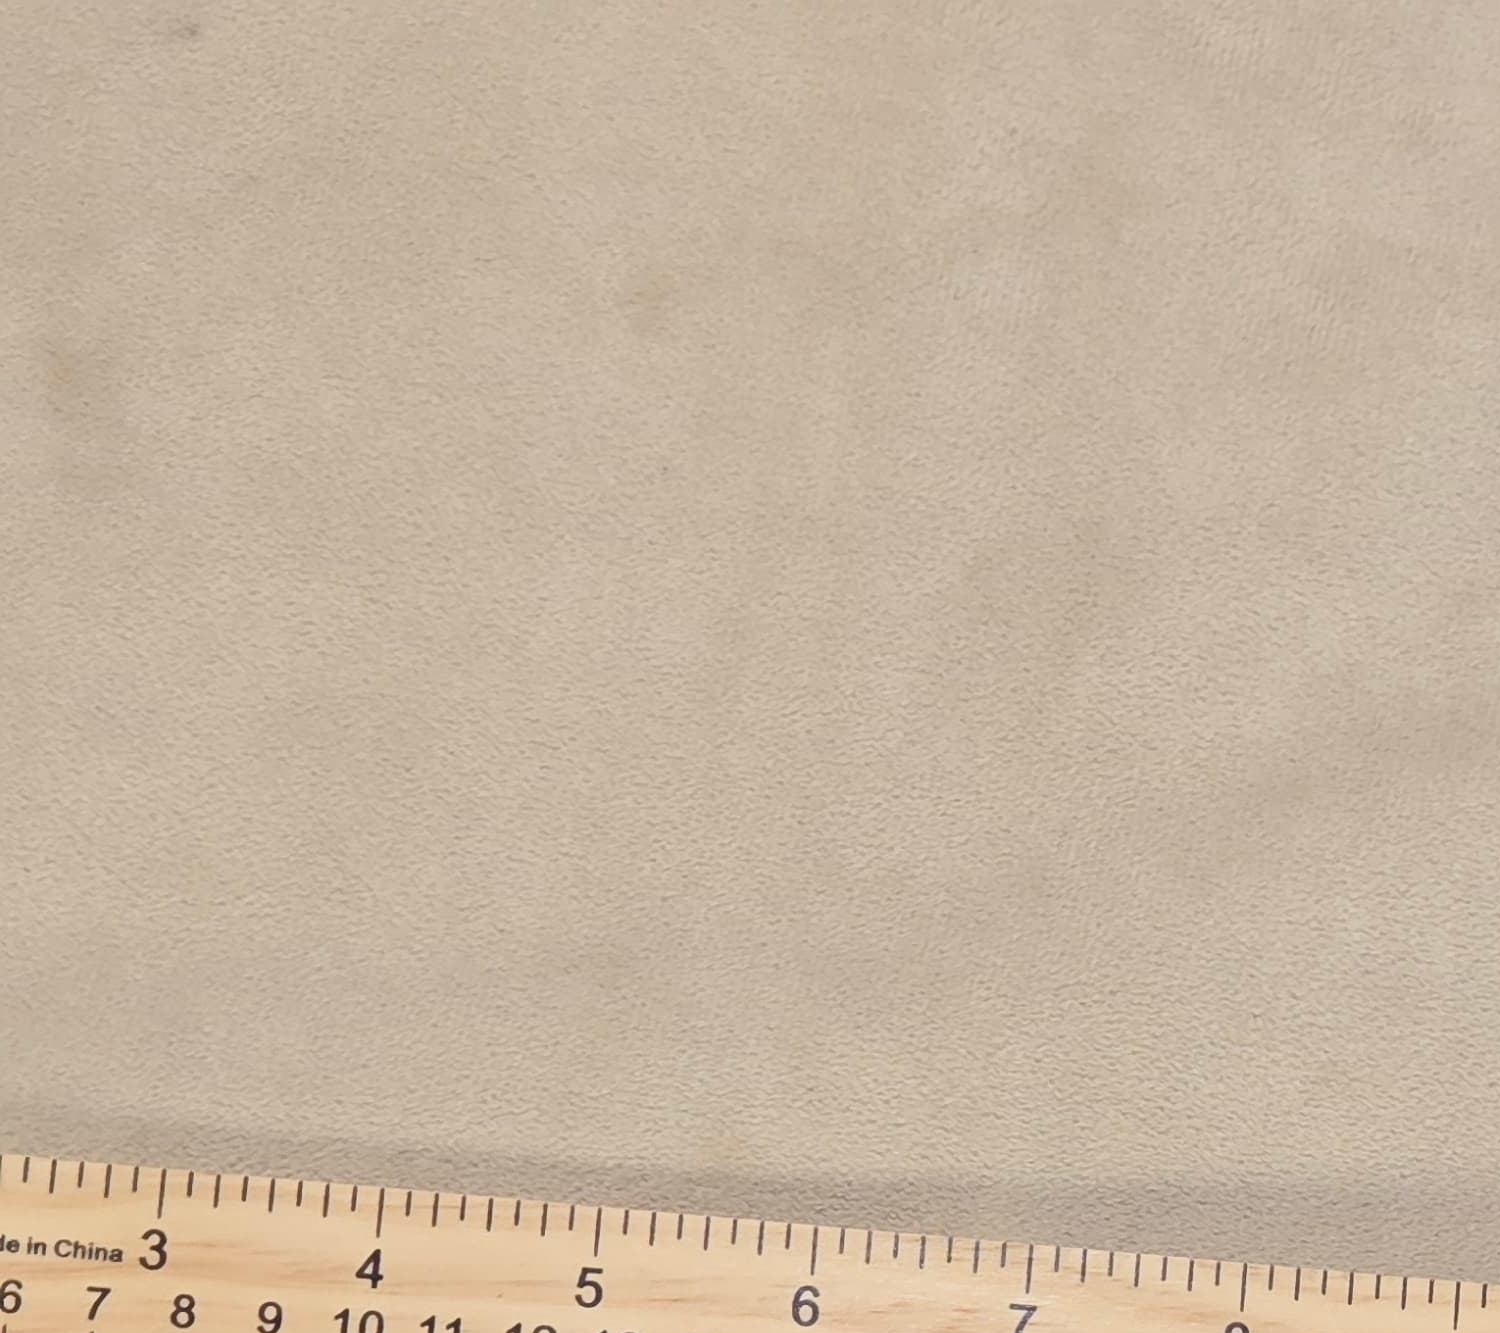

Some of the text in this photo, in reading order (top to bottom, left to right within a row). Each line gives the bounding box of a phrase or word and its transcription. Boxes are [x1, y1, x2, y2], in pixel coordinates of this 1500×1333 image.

[27, 1236, 47, 1256] in
[54, 1239, 123, 1262] China
[138, 1228, 168, 1271] 3
[354, 1248, 385, 1290] 4
[574, 1266, 604, 1309] 5
[791, 1284, 821, 1328] 6
[0, 1279, 23, 1314] 6
[86, 1285, 112, 1321] 7
[169, 1293, 196, 1329] 8
